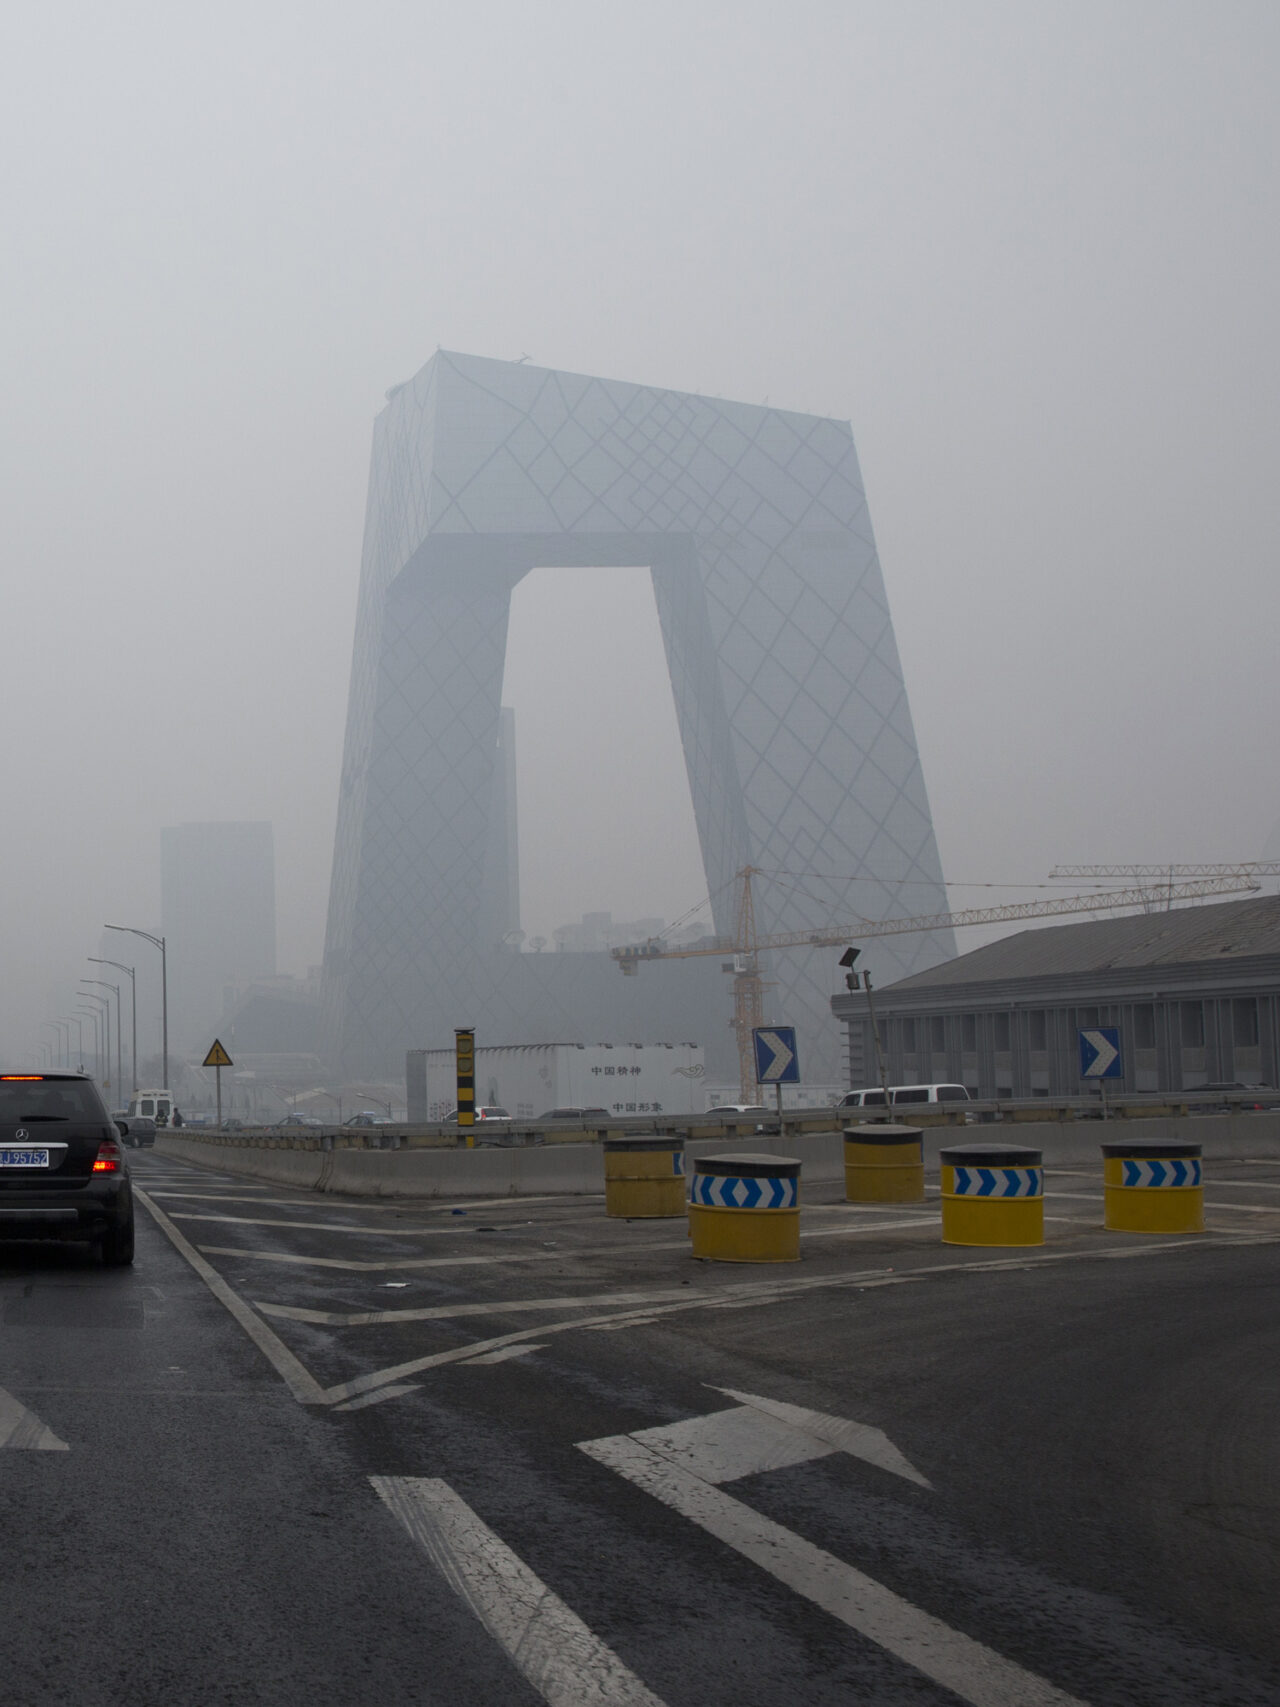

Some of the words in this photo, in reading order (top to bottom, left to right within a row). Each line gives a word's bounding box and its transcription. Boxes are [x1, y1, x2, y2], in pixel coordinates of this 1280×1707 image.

[591, 1065, 642, 1076] 中国精神
[612, 1101, 663, 1112] 中国形象
